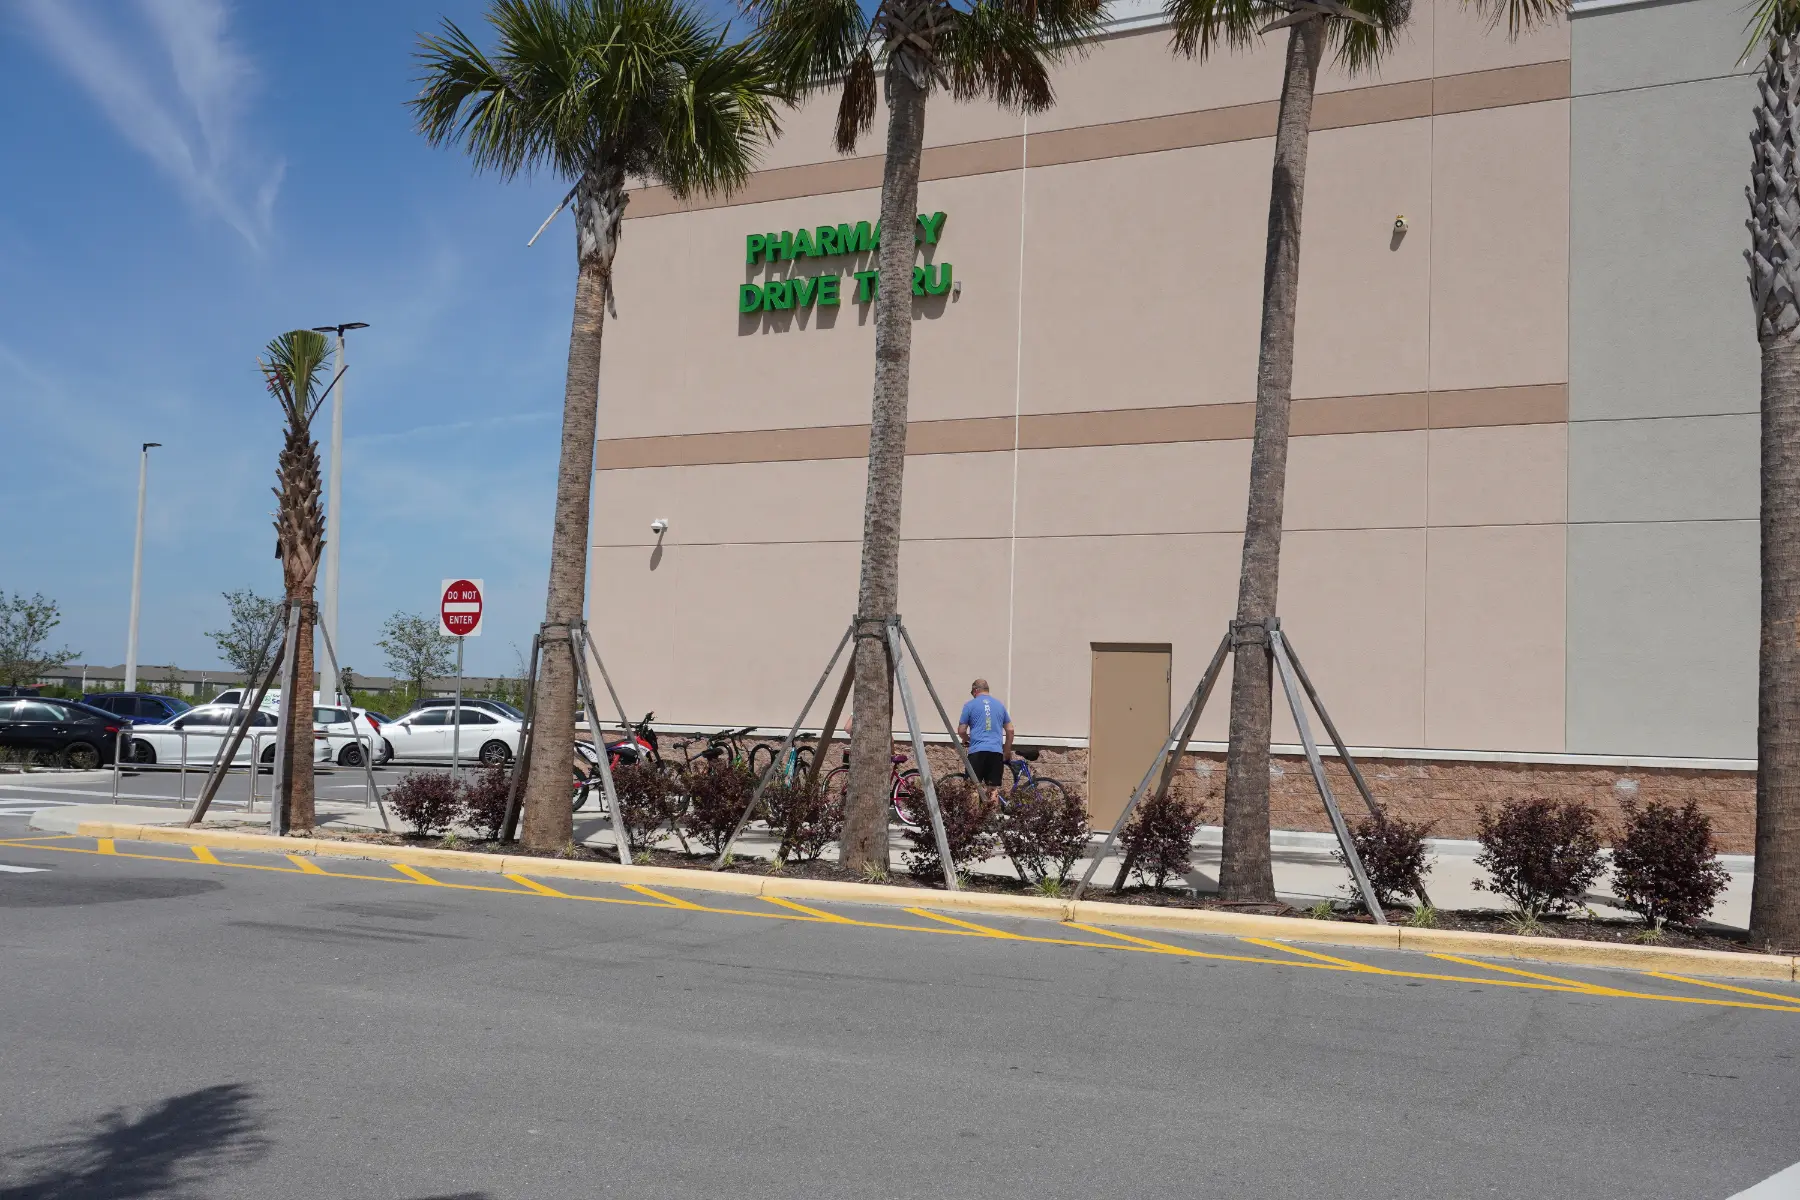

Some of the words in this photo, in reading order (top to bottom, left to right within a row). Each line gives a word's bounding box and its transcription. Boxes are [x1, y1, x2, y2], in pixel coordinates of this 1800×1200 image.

[746, 211, 947, 264] PHARMY
[739, 275, 841, 313] DRIVE
[854, 262, 953, 303] TRU
[447, 590, 458, 600] DO
[462, 590, 477, 600] NOT
[449, 615, 473, 625] ENTER
